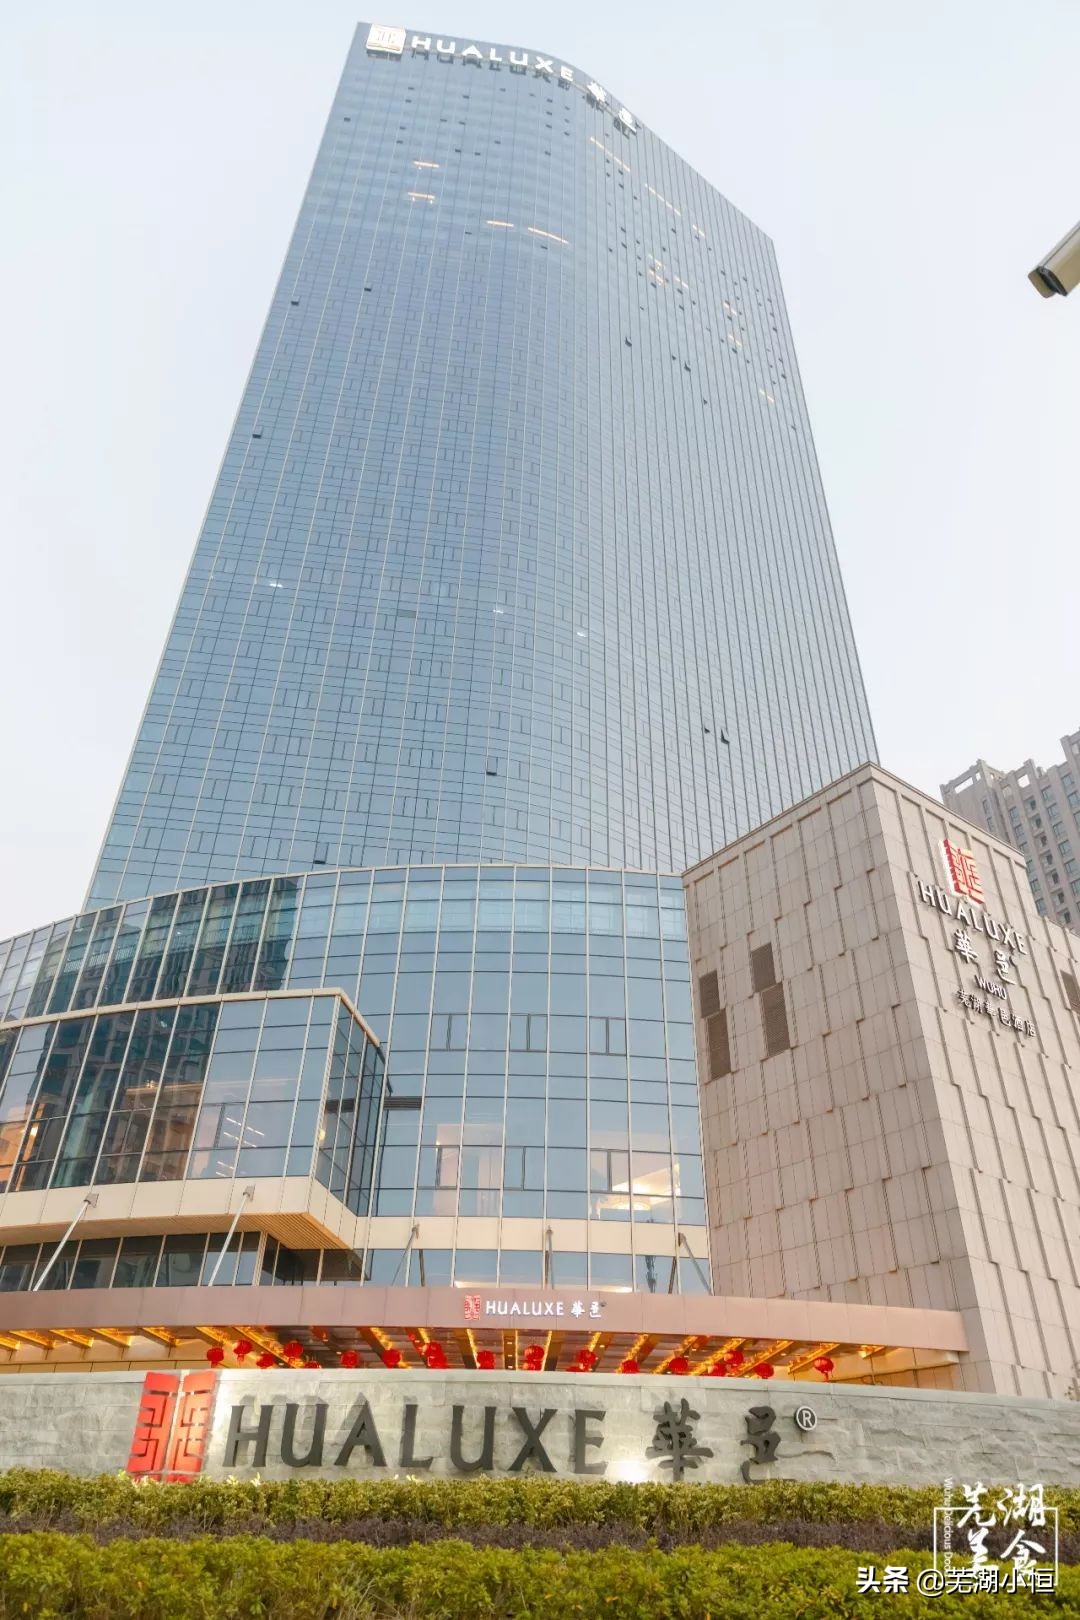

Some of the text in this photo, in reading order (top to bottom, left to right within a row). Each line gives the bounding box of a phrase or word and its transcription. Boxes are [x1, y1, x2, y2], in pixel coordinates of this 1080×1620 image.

[411, 35, 574, 81] HUALUXE
[917, 880, 1028, 955] HUALUXE
[974, 974, 1008, 1000] WUHU
[485, 1301, 565, 1316] HUALUXE
[222, 1397, 609, 1475] HUALUXE
